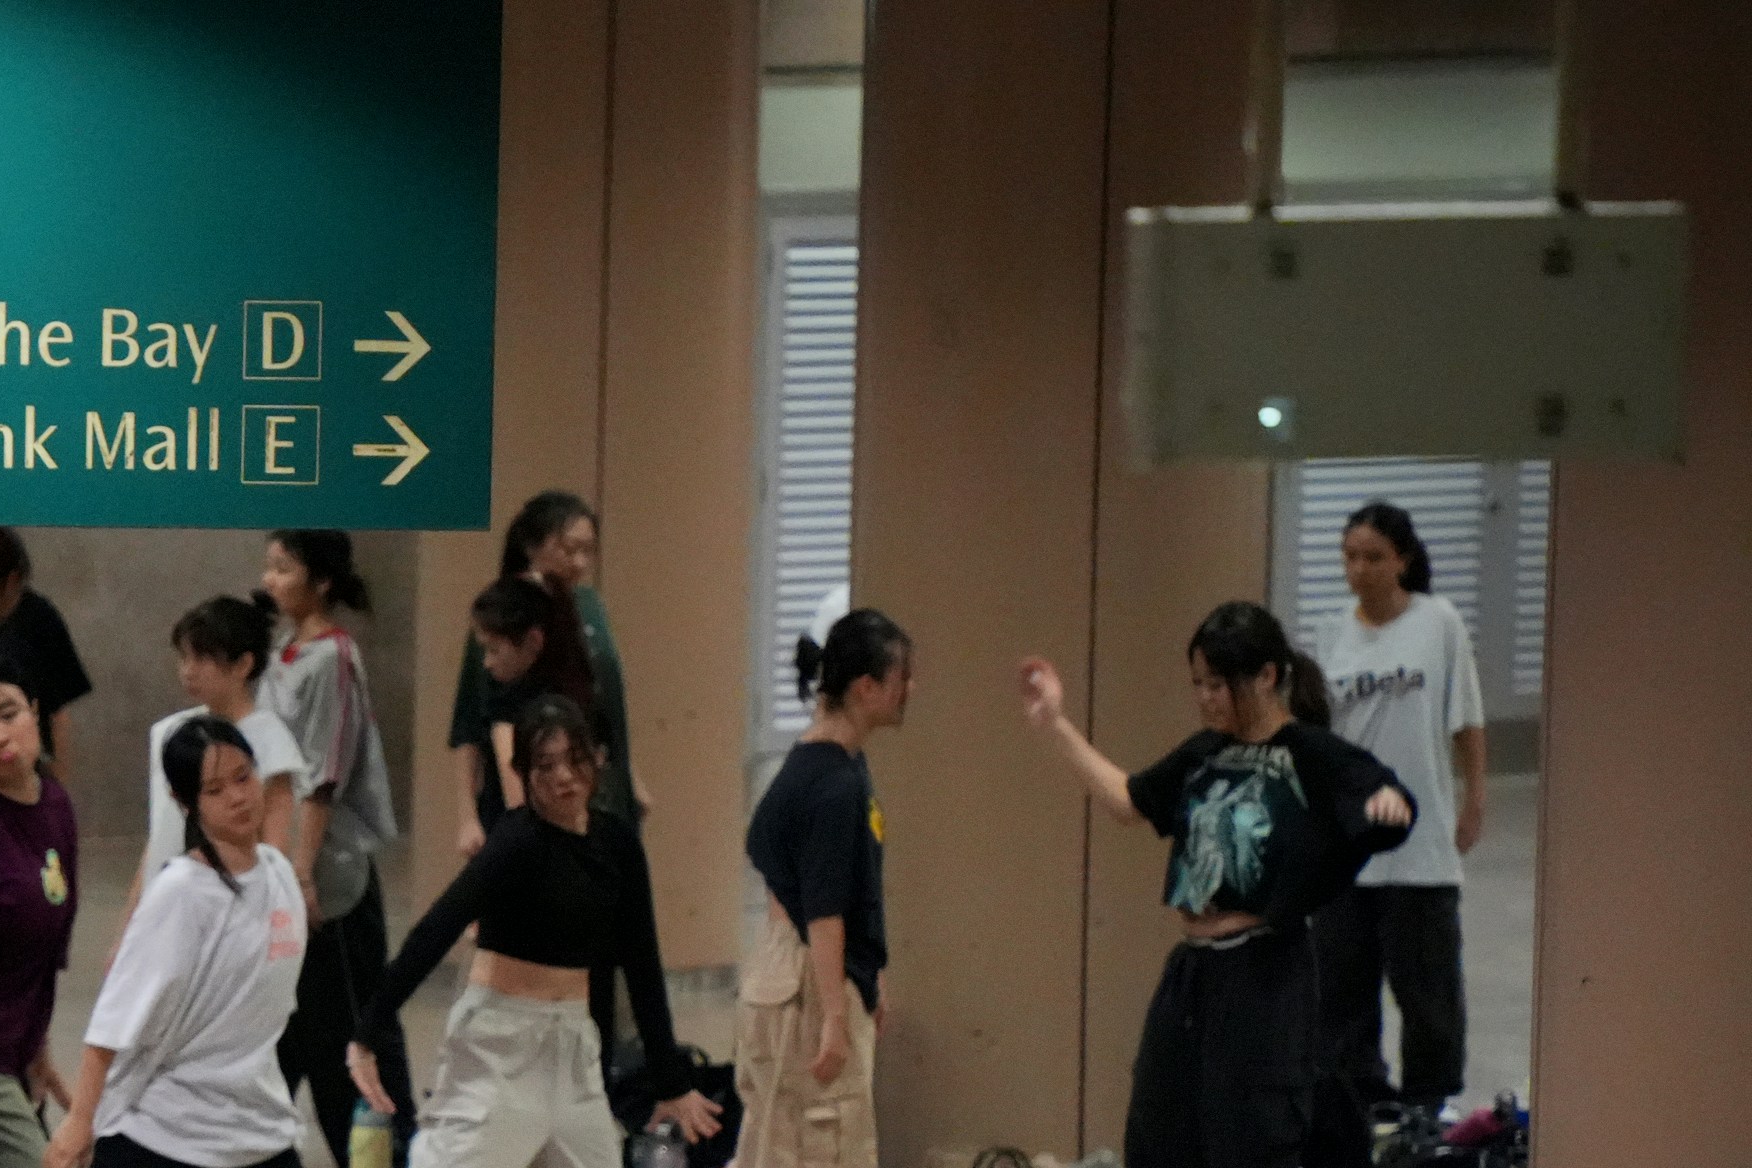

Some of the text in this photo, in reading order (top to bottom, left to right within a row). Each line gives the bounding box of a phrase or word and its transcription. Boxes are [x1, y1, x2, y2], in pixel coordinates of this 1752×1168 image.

[101, 307, 218, 384] Bay
[261, 311, 305, 370] D
[85, 406, 220, 472] Mall
[264, 415, 296, 475] E
